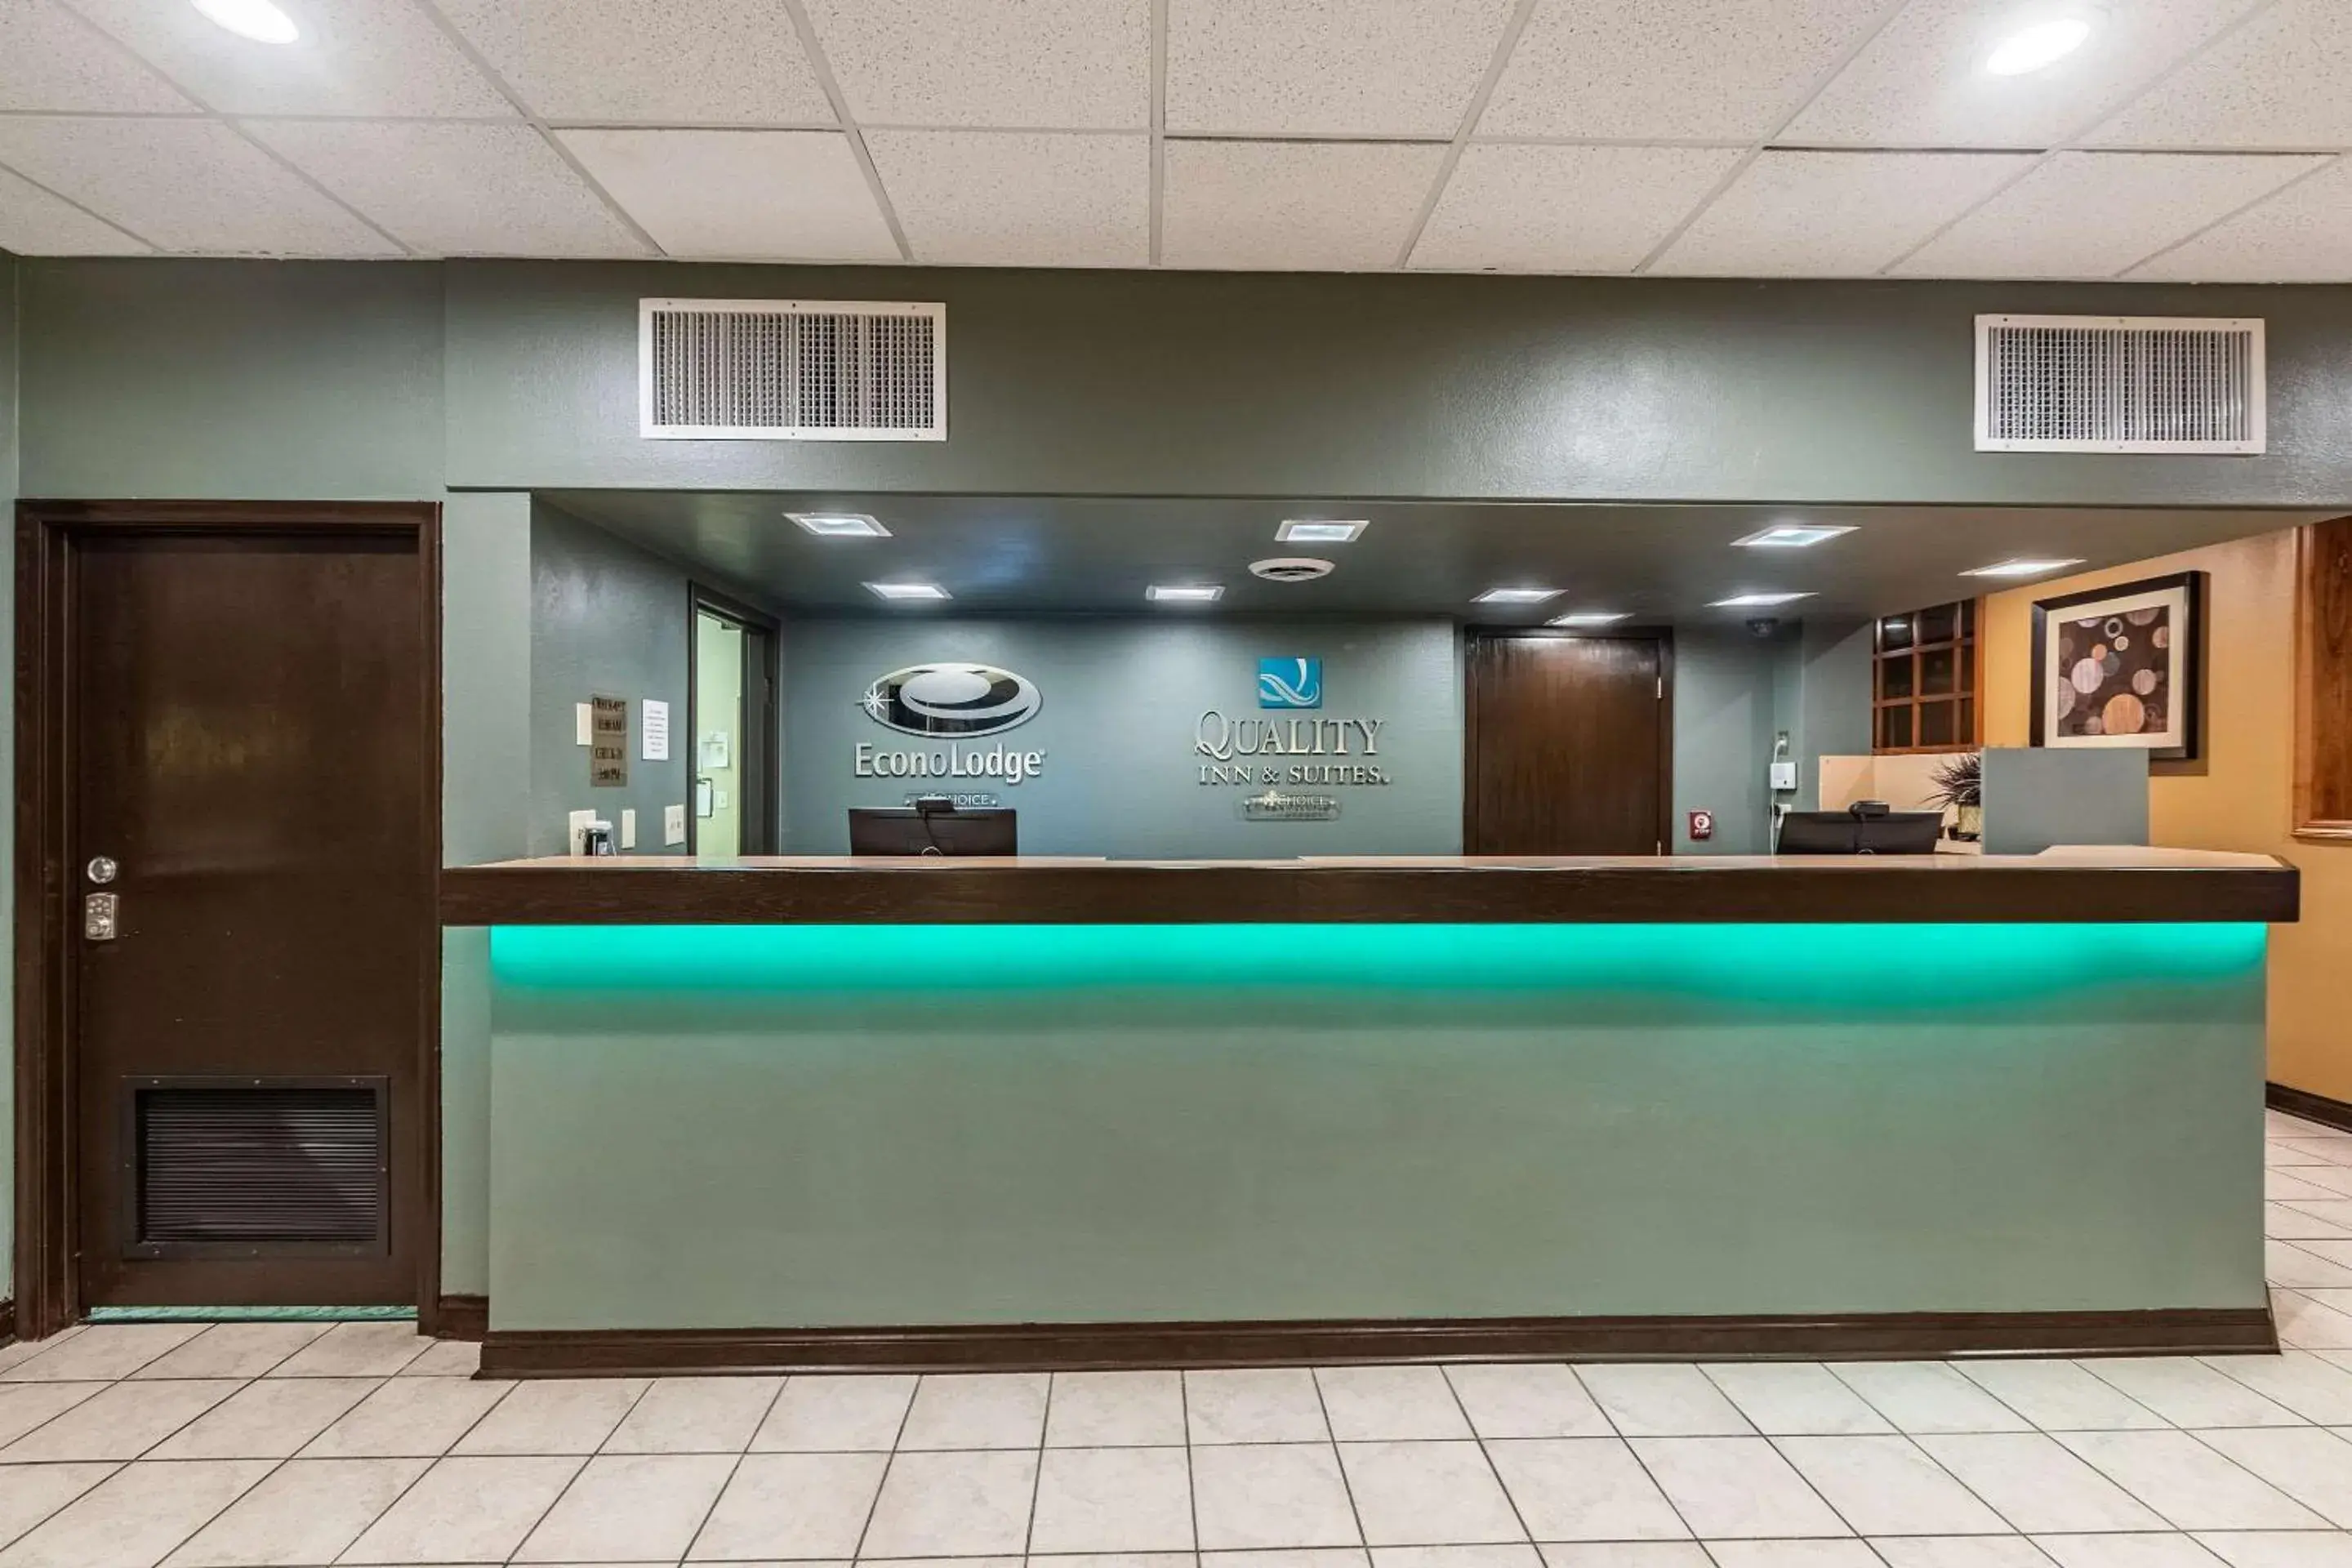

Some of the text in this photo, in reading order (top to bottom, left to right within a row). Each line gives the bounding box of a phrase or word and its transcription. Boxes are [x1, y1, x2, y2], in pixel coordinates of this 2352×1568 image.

[1195, 710, 1383, 760] QUALITY
[854, 743, 1042, 786] EconoLodge
[1199, 764, 1252, 785] INN
[1262, 765, 1280, 784] &
